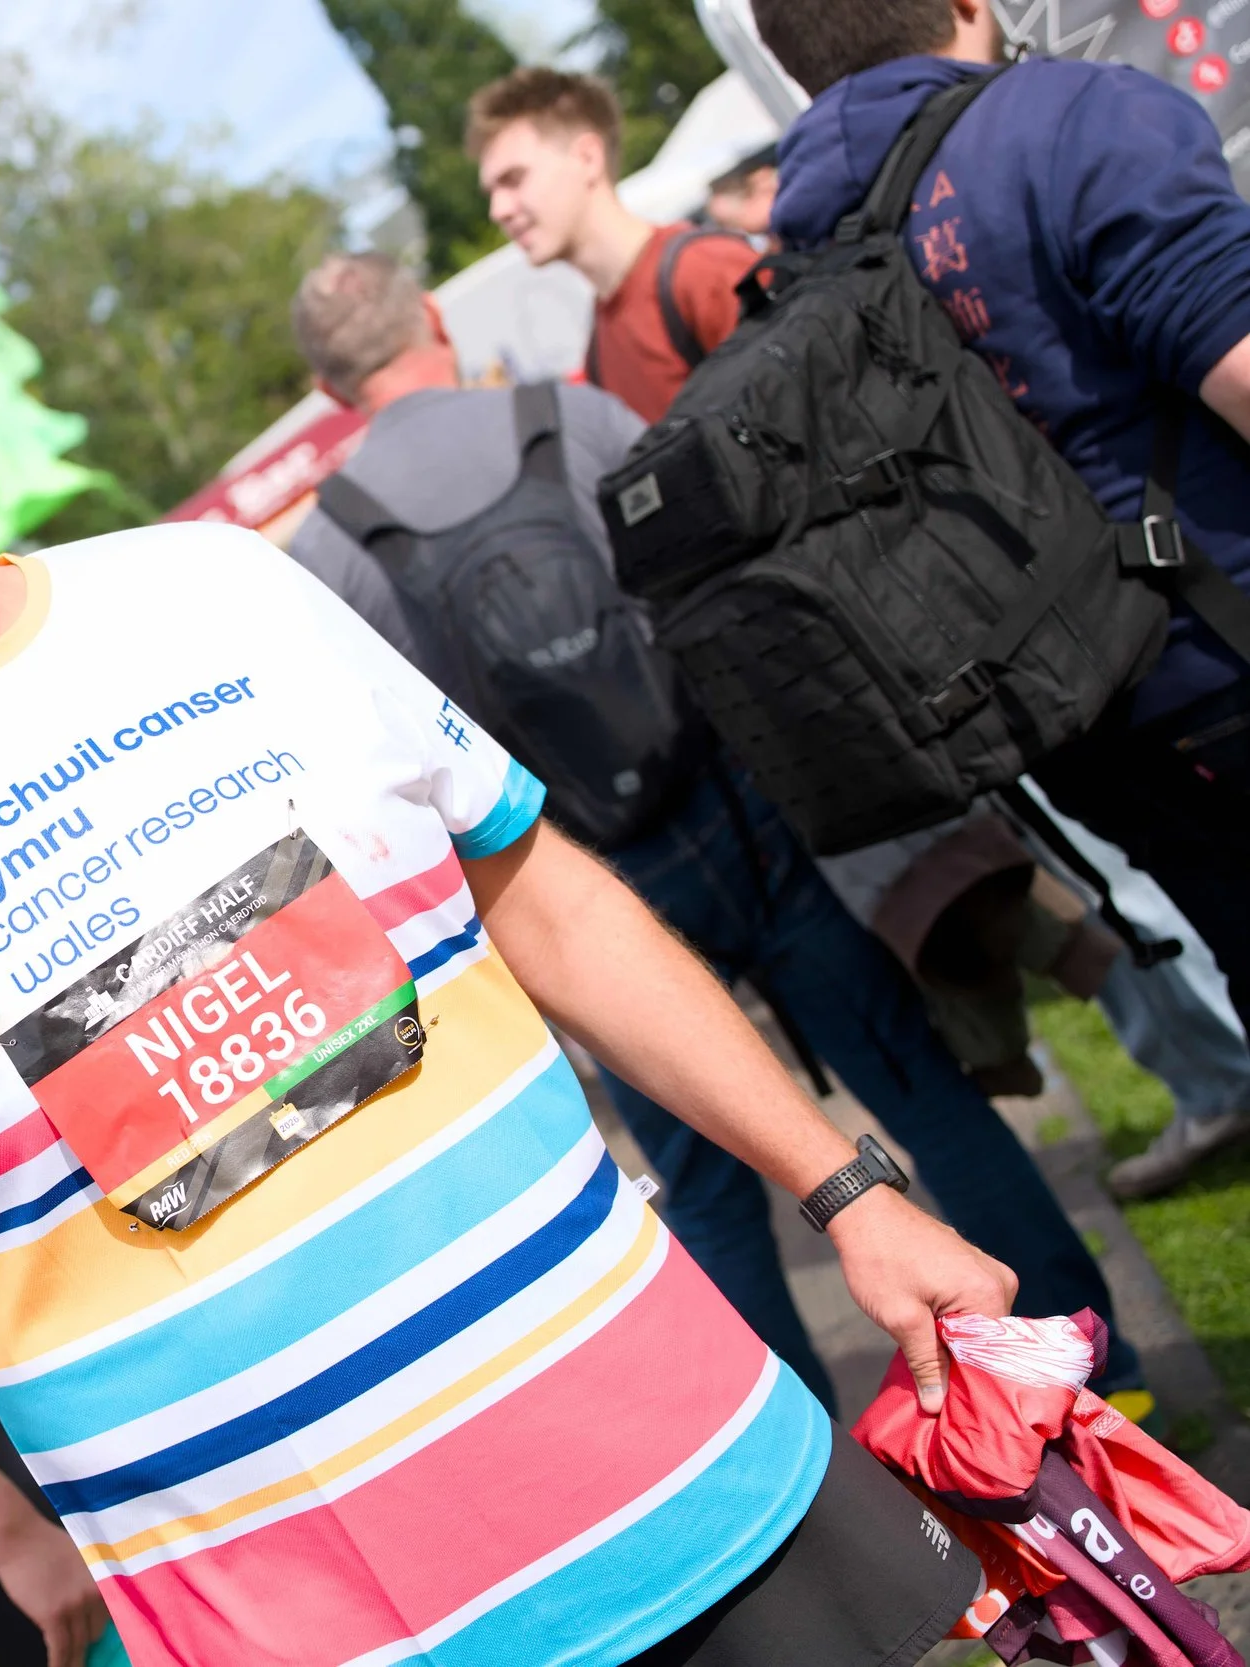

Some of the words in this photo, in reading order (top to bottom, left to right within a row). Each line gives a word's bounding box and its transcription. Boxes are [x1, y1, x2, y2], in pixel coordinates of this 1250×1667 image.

[112, 676, 256, 752] canser
[124, 747, 306, 858] research
[10, 896, 141, 994] wales
[115, 913, 201, 984] CARDIFF
[199, 874, 257, 925] HALF
[164, 929, 220, 972] MARATHON
[218, 894, 268, 933] CAERDYDD
[124, 950, 292, 1077] NIGEL
[312, 1030, 359, 1064] UNISEX
[354, 1014, 380, 1035] 2XL
[158, 988, 326, 1124] 18836
[166, 1148, 192, 1169] RED
[279, 1115, 301, 1134] 2026
[149, 1182, 188, 1223] R4W
